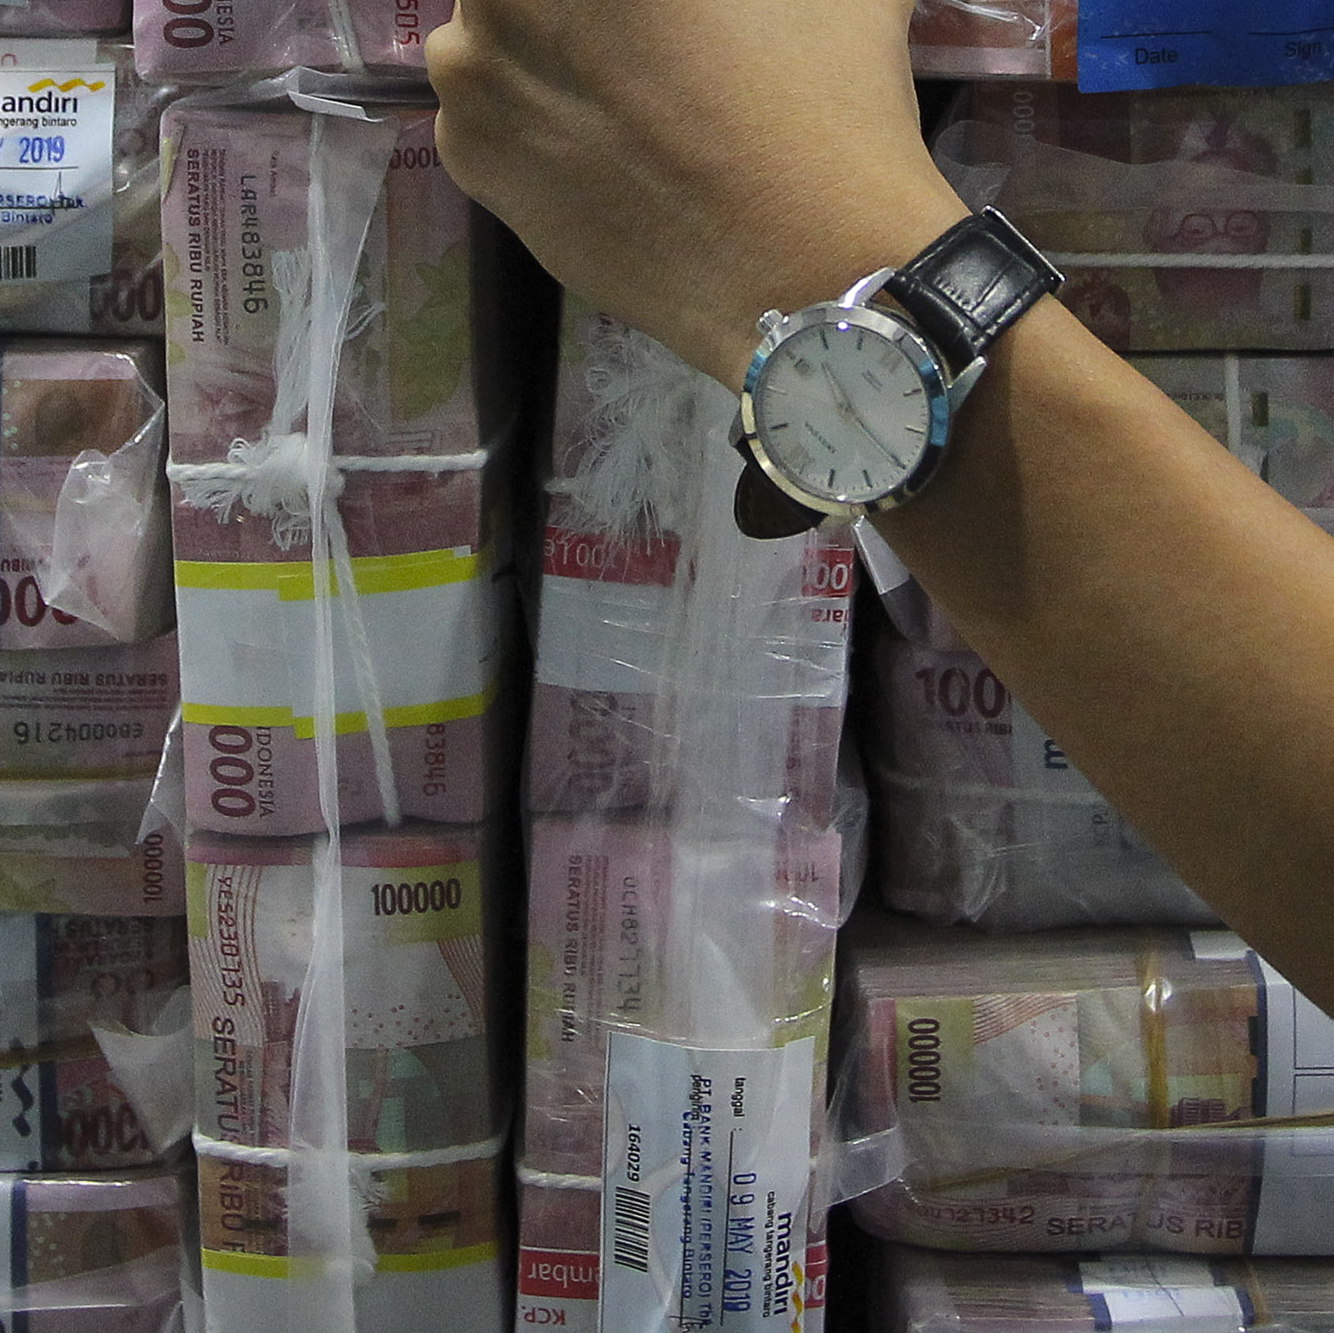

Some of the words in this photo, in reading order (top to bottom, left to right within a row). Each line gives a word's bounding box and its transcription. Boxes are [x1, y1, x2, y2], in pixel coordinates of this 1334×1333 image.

[1134, 47, 1179, 67] Date
[1284, 39, 1325, 60] Sign
[41, 116, 78, 128] bintaro
[18, 135, 66, 164] 2019
[186, 148, 201, 227] SERATUS
[188, 233, 203, 274] RIBU
[239, 174, 269, 315] LAR483846
[189, 279, 205, 344] RUPIAH
[95, 672, 168, 687] SERATUS
[370, 877, 462, 916] 100000
[565, 854, 583, 932] SERATUS
[907, 1017, 942, 1105] 100000
[732, 1076, 747, 1117] tanggal
[698, 1103, 712, 1147] BANK
[626, 1123, 642, 1183] 164029
[219, 1161, 248, 1233] RIBU
[698, 1150, 712, 1213] MANDIRI
[763, 1192, 776, 1229] cabang
[726, 1217, 754, 1254] MAY
[762, 1231, 776, 1282] tangerang
[772, 1212, 795, 1315] mandiri
[521, 1305, 565, 1326] KCP.
[761, 1283, 774, 1318] bintaro
